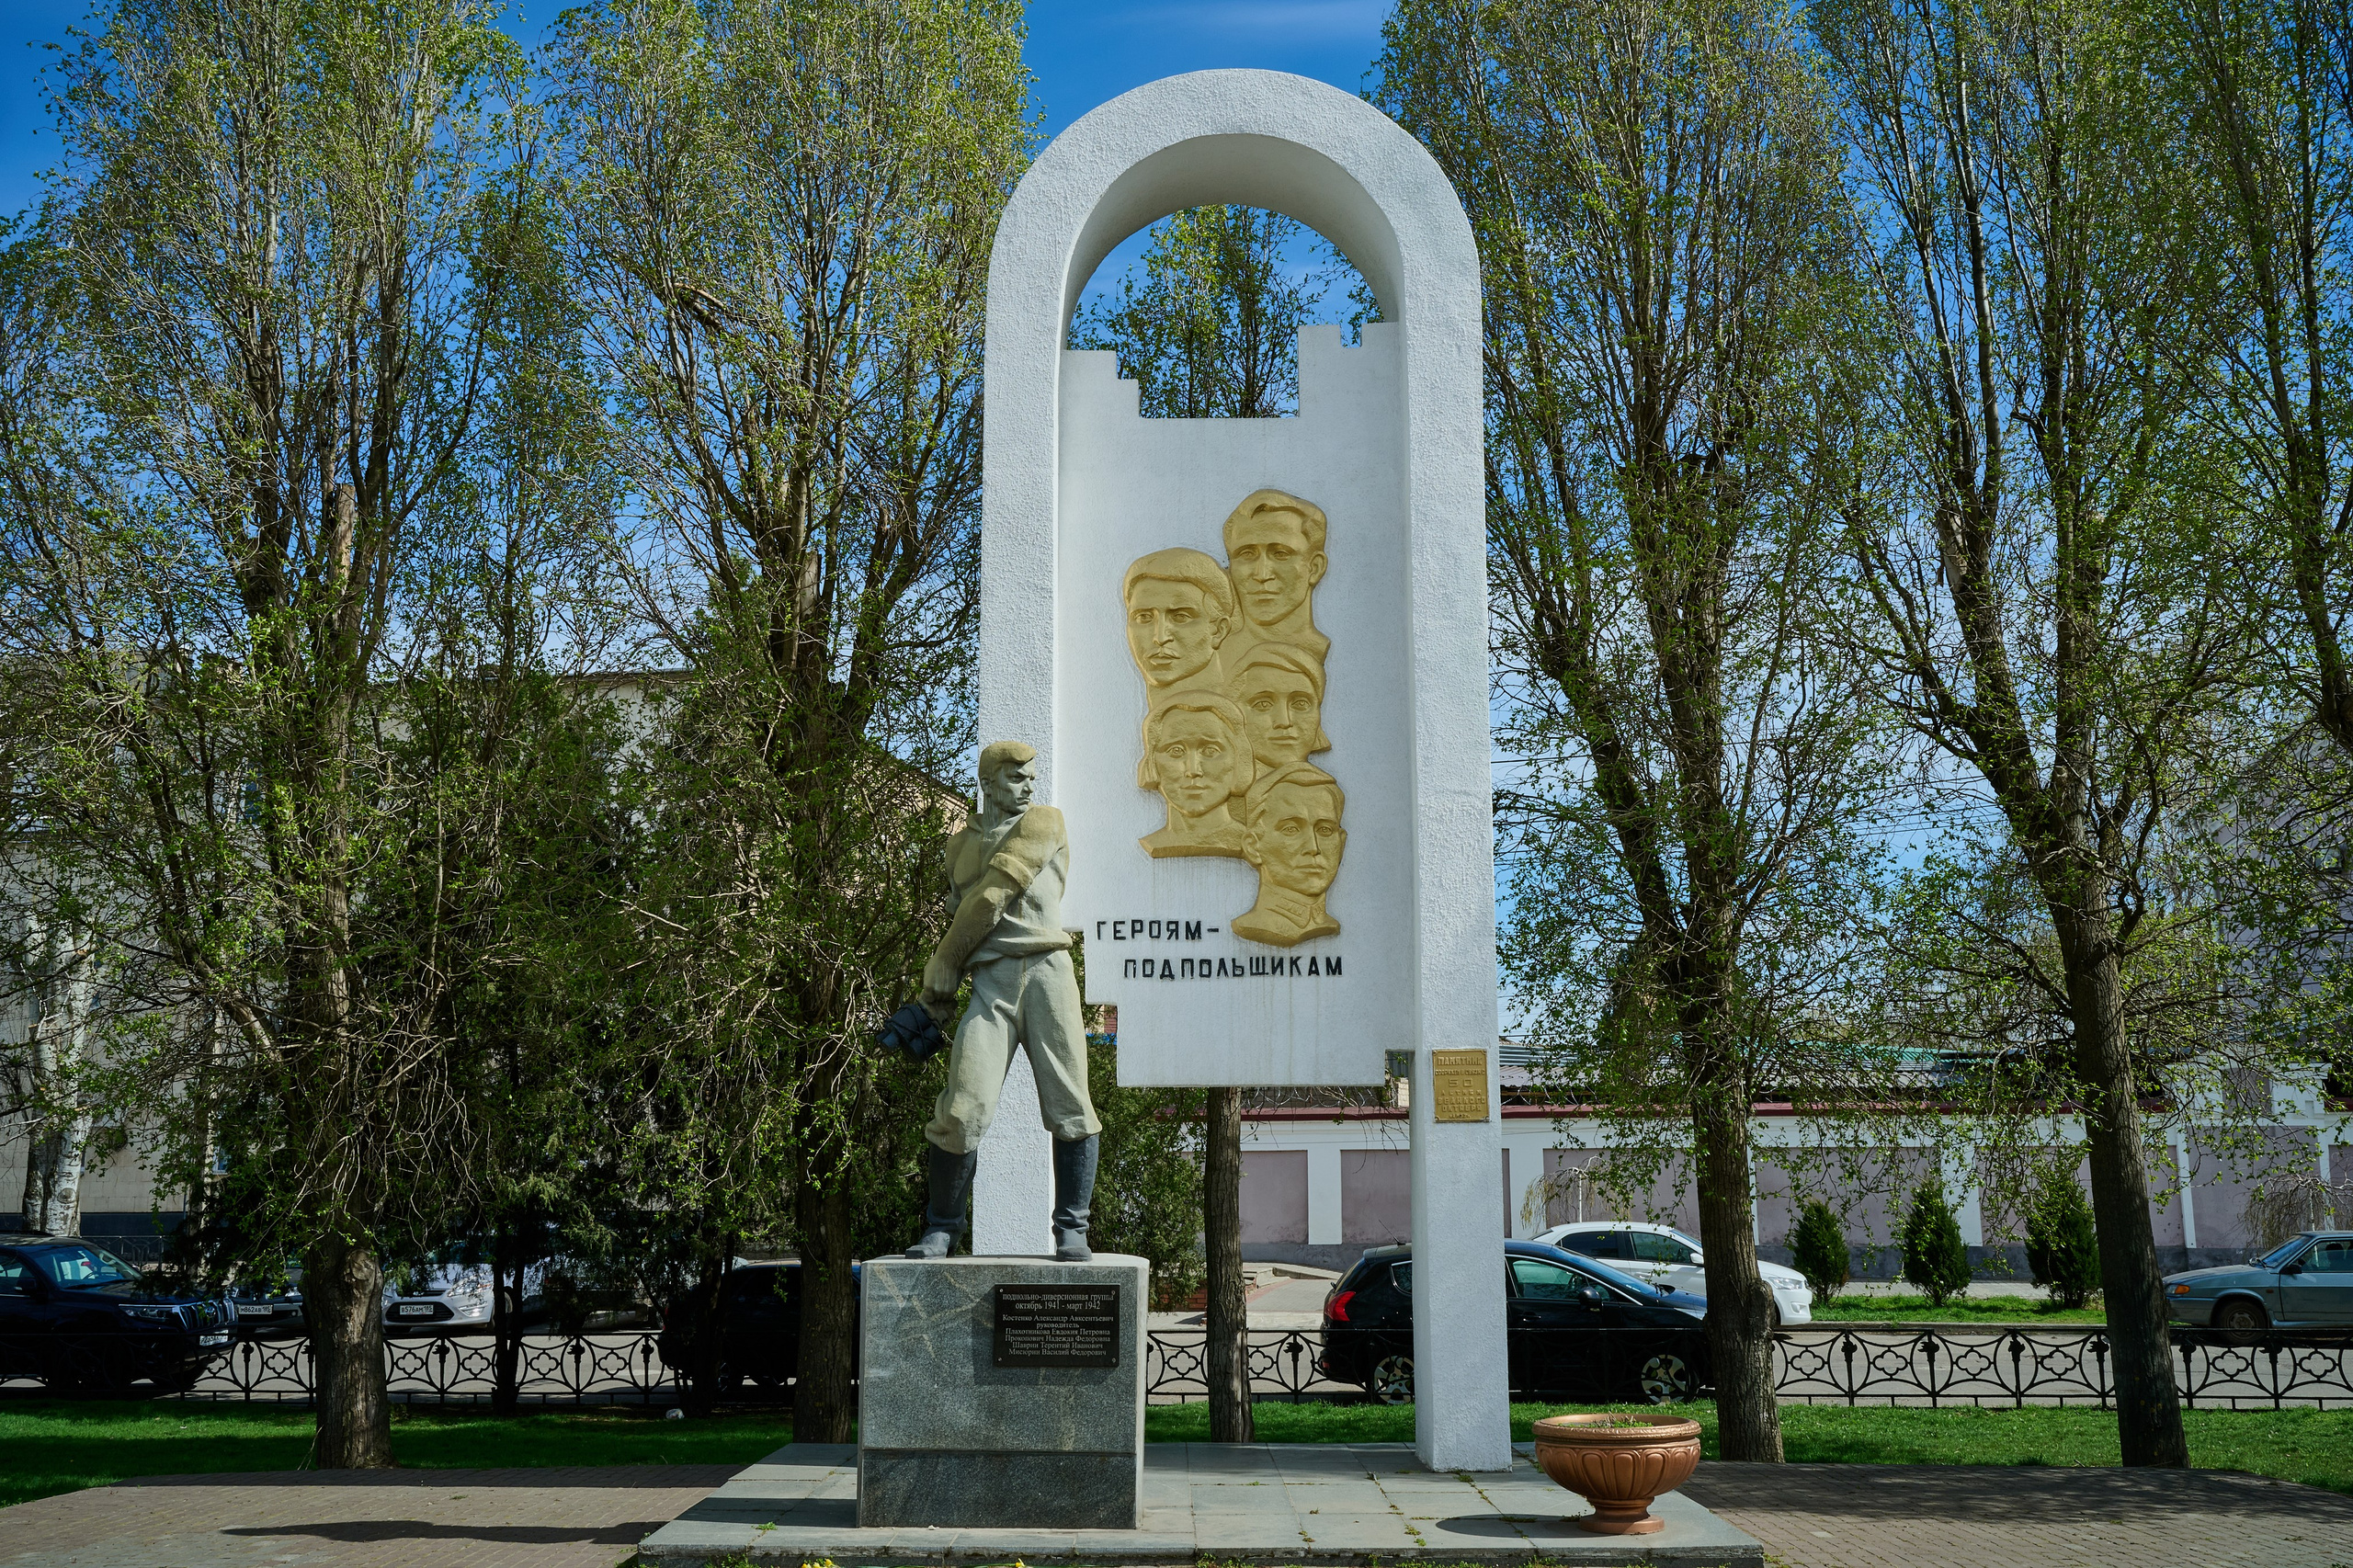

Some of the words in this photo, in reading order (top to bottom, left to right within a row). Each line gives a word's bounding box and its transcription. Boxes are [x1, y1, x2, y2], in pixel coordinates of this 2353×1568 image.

[1097, 920, 1220, 940] ГЕРОЯМ-
[1123, 956, 1343, 980] ПОДПОЛЬЩИКАМ
[1438, 1056, 1483, 1065] ПАМЯТНИК
[1448, 1078, 1472, 1087] 50
[1438, 1096, 1485, 1105] ВЕЛИКОГО
[1015, 1301, 1042, 1311] октябрь
[1045, 1301, 1060, 1310] 1941
[1085, 1301, 1100, 1310] 1942
